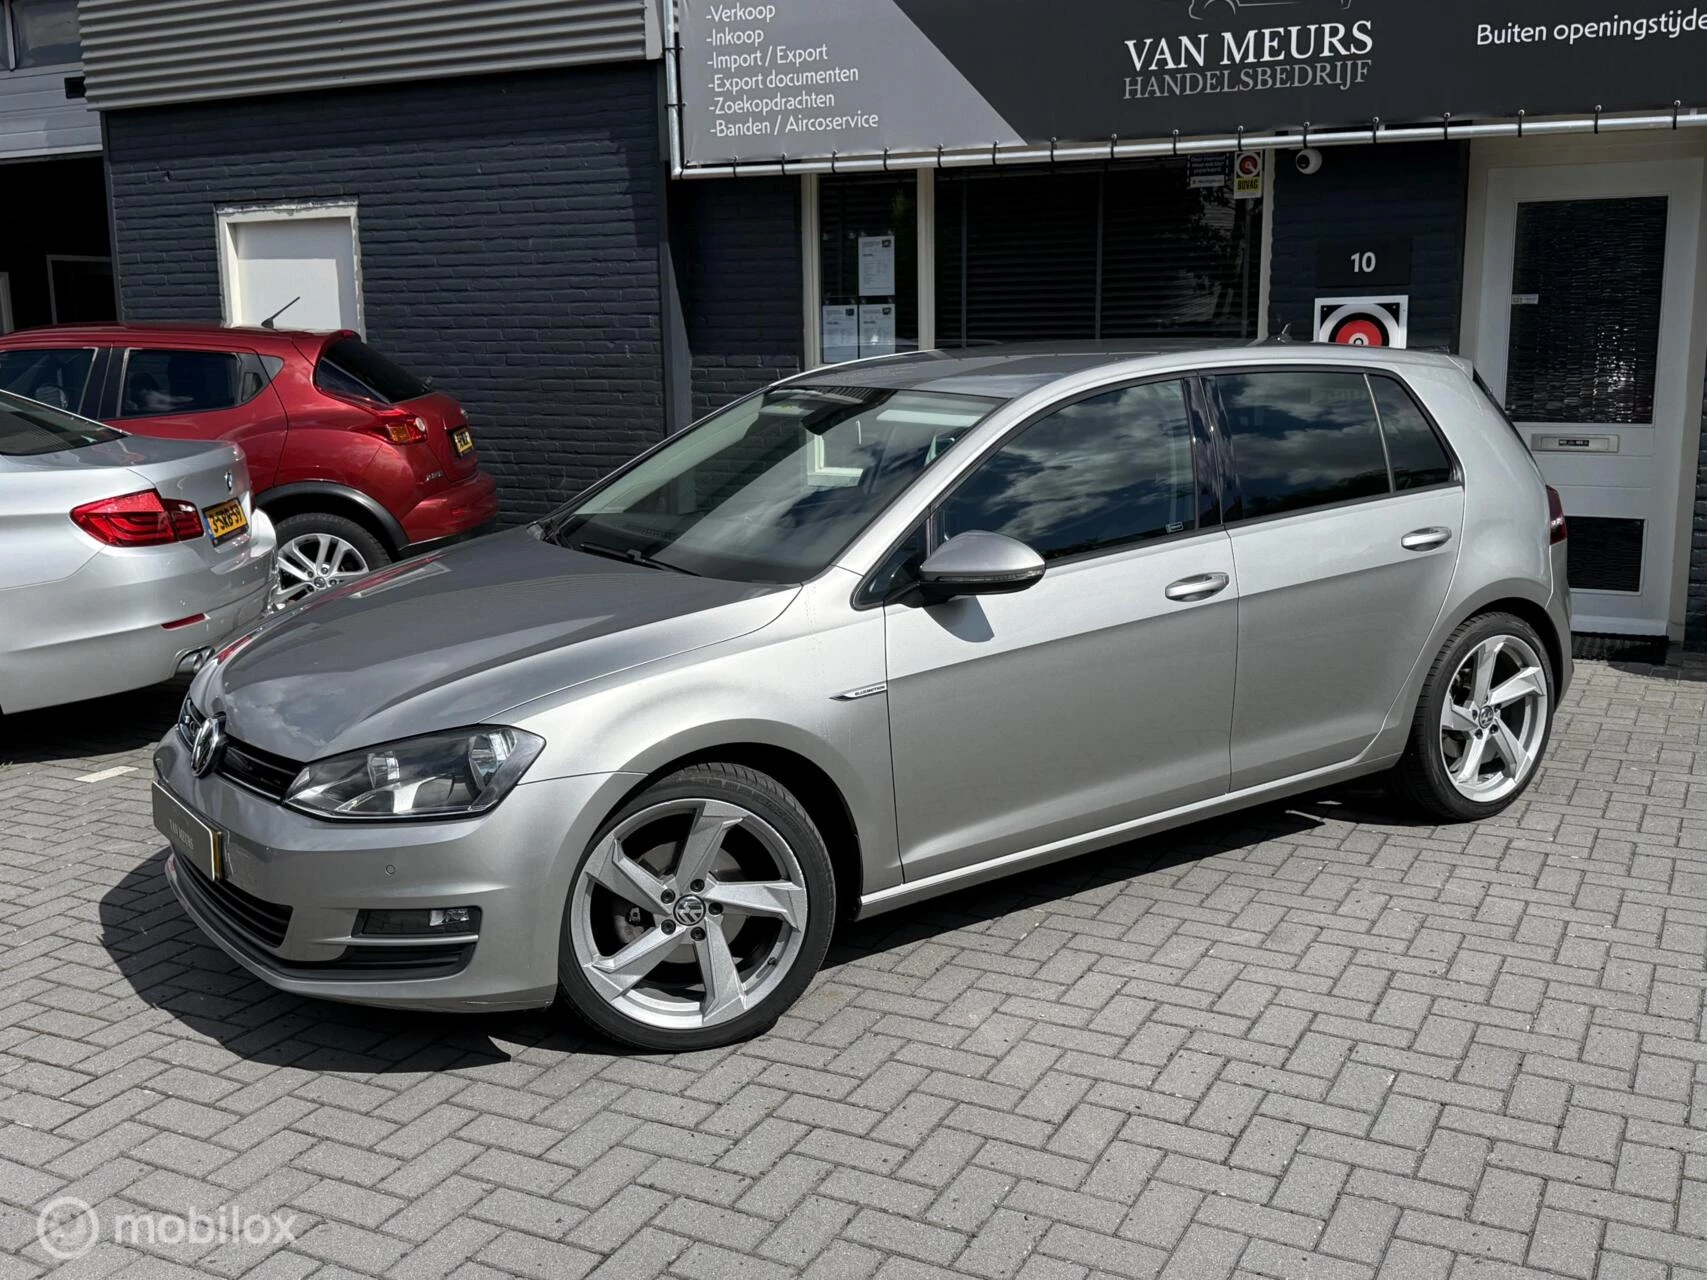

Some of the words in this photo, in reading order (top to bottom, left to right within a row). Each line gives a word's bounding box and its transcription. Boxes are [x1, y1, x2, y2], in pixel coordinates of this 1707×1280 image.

[706, 2, 776, 23] -Verkoop
[706, 26, 764, 47] -Inkoop
[1124, 33, 1209, 72] VAN
[1219, 20, 1374, 66] MEURS
[1477, 22, 1547, 46] Buiten
[707, 50, 762, 72] -Import
[776, 44, 828, 66] Export
[708, 73, 763, 94] -Export
[766, 67, 859, 89] documenten
[1123, 60, 1373, 99] HANDELSBEDRIJF
[708, 91, 835, 117] -Zoekopdrachten
[710, 116, 770, 138] -Banden
[785, 110, 879, 133] Aircoservice
[1350, 251, 1376, 273] 10
